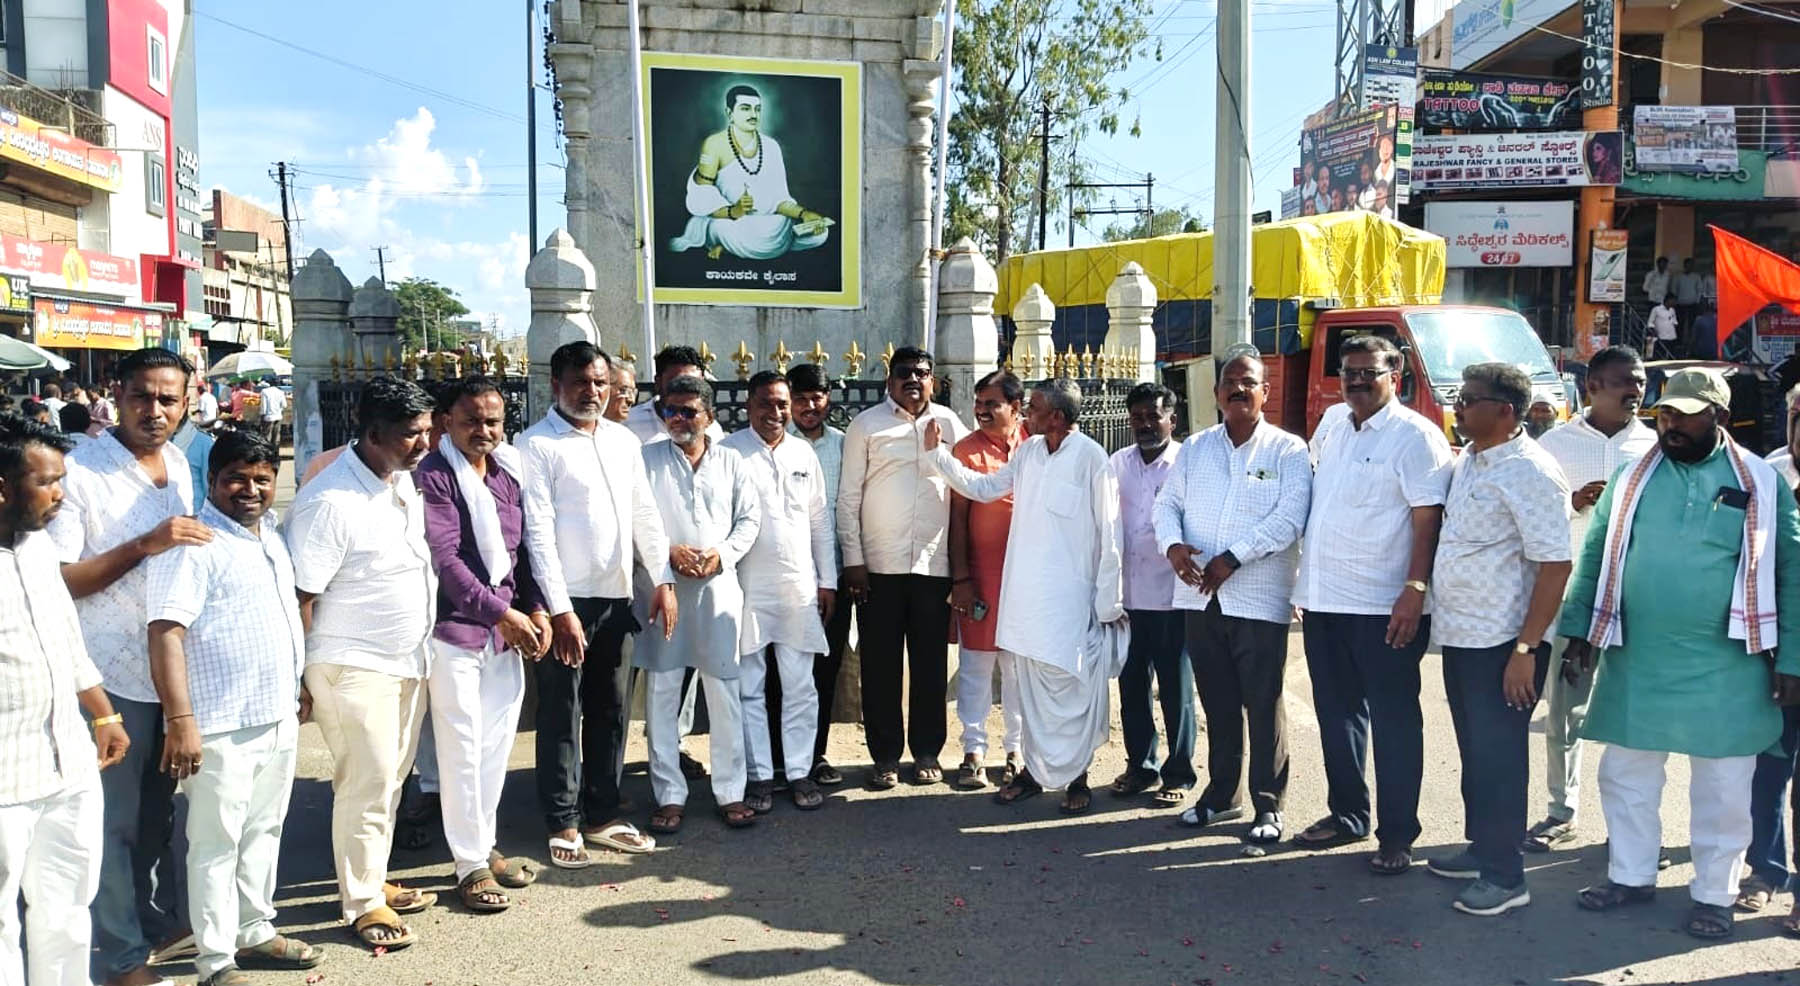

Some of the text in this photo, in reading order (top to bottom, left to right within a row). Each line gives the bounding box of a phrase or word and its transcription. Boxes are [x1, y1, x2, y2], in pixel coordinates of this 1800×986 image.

[1392, 58, 1416, 67] COLLEGE
[1423, 97, 1480, 112] TATTOO
[1413, 159, 1464, 167] RAJESHWAR
[1504, 157, 1543, 165] GENERAL
[1546, 156, 1578, 164] STORES
[1512, 232, 1569, 248] ಮೆಡಿಕಲ್ಸ್
[11, 277, 29, 293] UK
[706, 270, 797, 285] ಕಾಯಕವೇ ಕೈಲಾಸ
